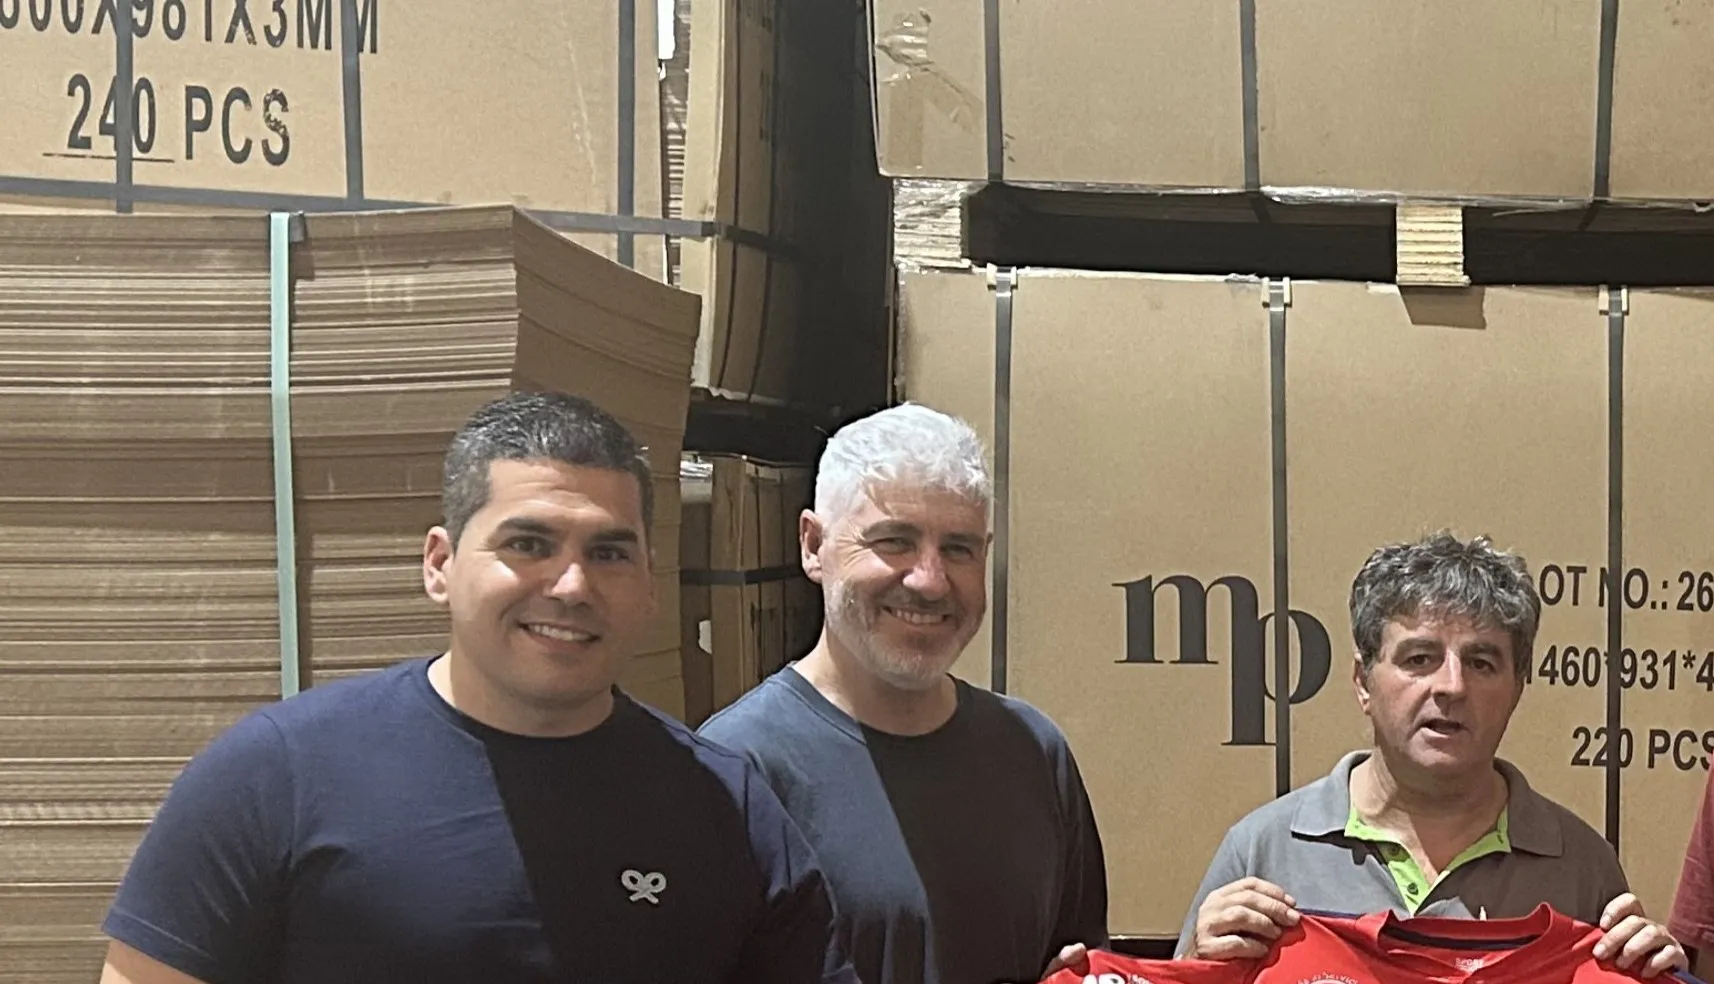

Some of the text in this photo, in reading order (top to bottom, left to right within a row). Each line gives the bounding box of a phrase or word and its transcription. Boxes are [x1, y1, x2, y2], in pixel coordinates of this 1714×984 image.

[67, 73, 290, 166] 240 PCS
[1539, 564, 1588, 607] OT
[1111, 574, 1332, 745] mp
[1570, 725, 1634, 770] 220
